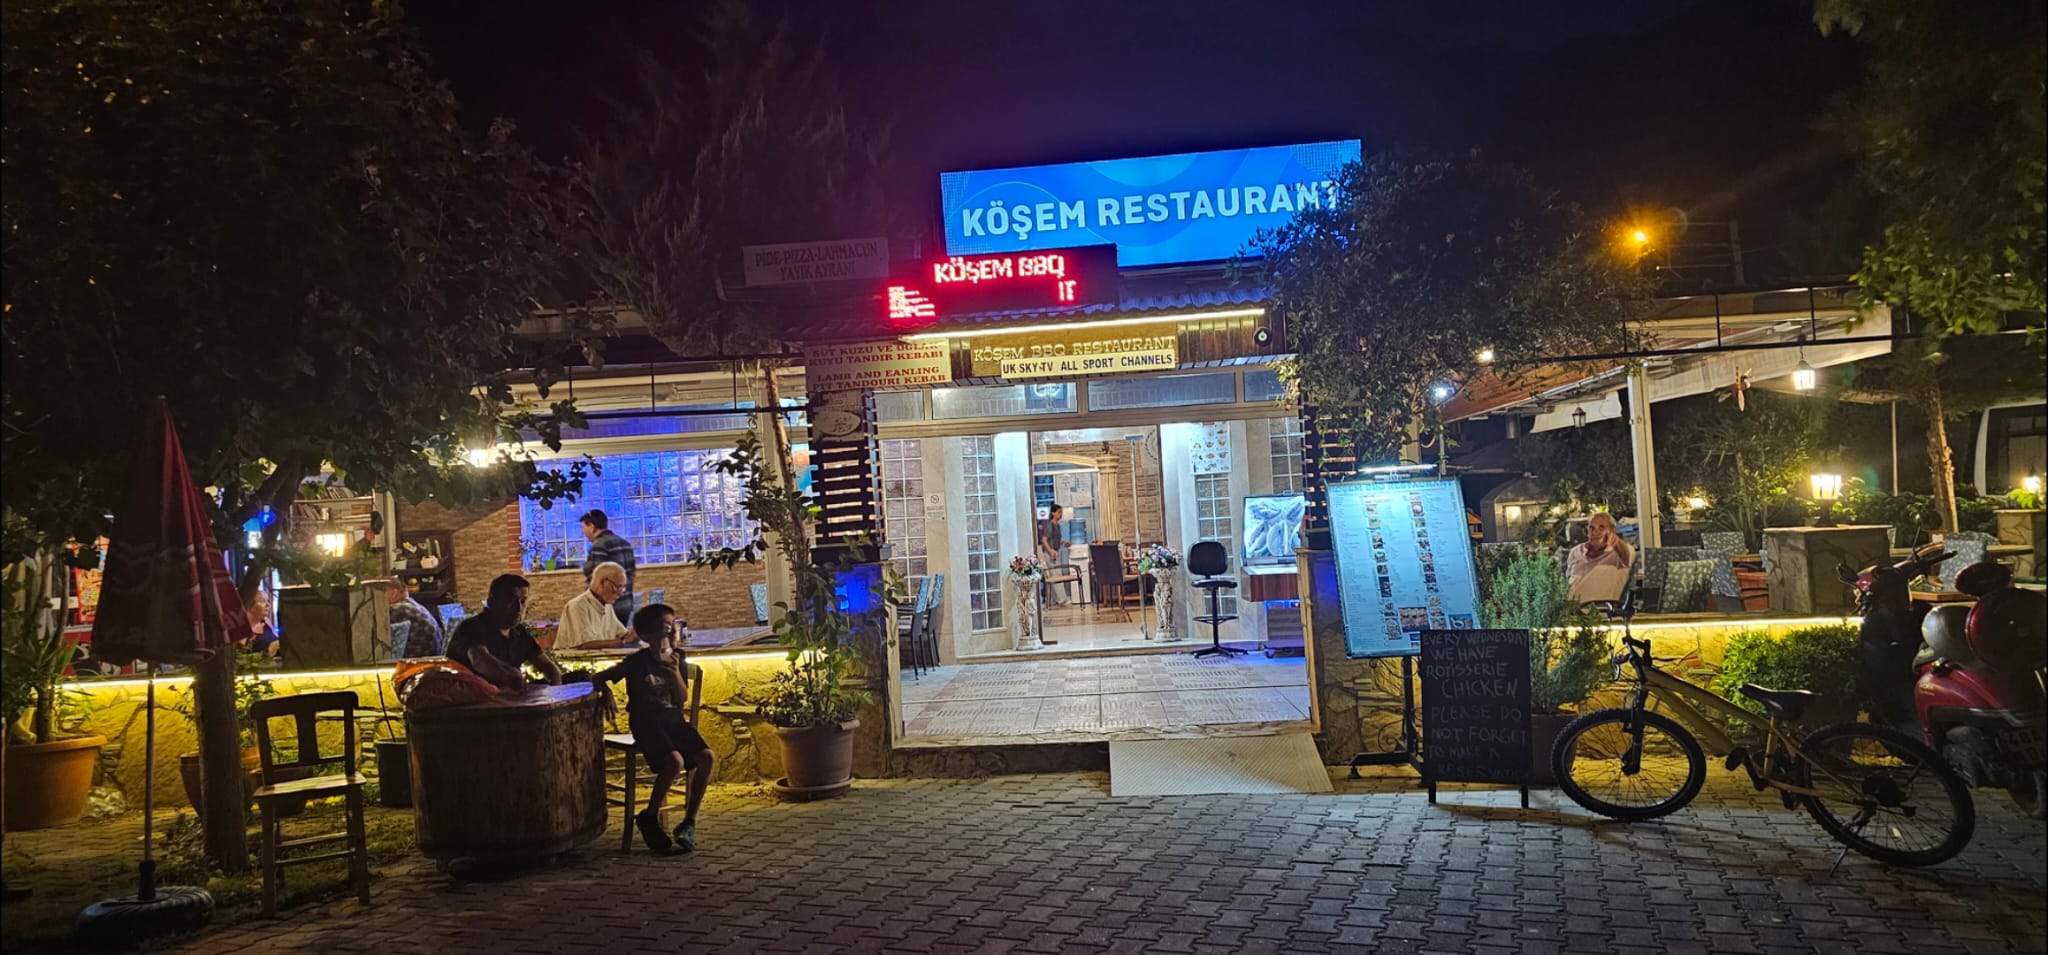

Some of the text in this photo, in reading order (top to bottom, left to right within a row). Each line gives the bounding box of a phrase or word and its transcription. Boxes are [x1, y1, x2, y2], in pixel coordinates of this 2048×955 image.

[962, 180, 1338, 240] KÖŞEM RESTAURANT
[934, 257, 1012, 284] KÖŞEM
[846, 354, 893, 364] TANDIR
[897, 351, 944, 360] KEBABI
[974, 336, 1176, 365] KÖŞEM BBQ RESTAURANT
[1061, 361, 1078, 371] ALL
[1083, 358, 1114, 370] SPORT
[1121, 354, 1173, 367] CHANNELS
[856, 371, 881, 380] AND
[885, 367, 939, 377] EANLING
[836, 378, 899, 390] TANDOURI
[904, 375, 946, 385] KEBAB
[1423, 633, 1461, 646] EVERY
[1430, 645, 1499, 663] WE HAVE
[1441, 678, 1519, 699] CHICKEN
[1431, 704, 1523, 724] PLEASE DO
[1431, 728, 1464, 744] NOT
